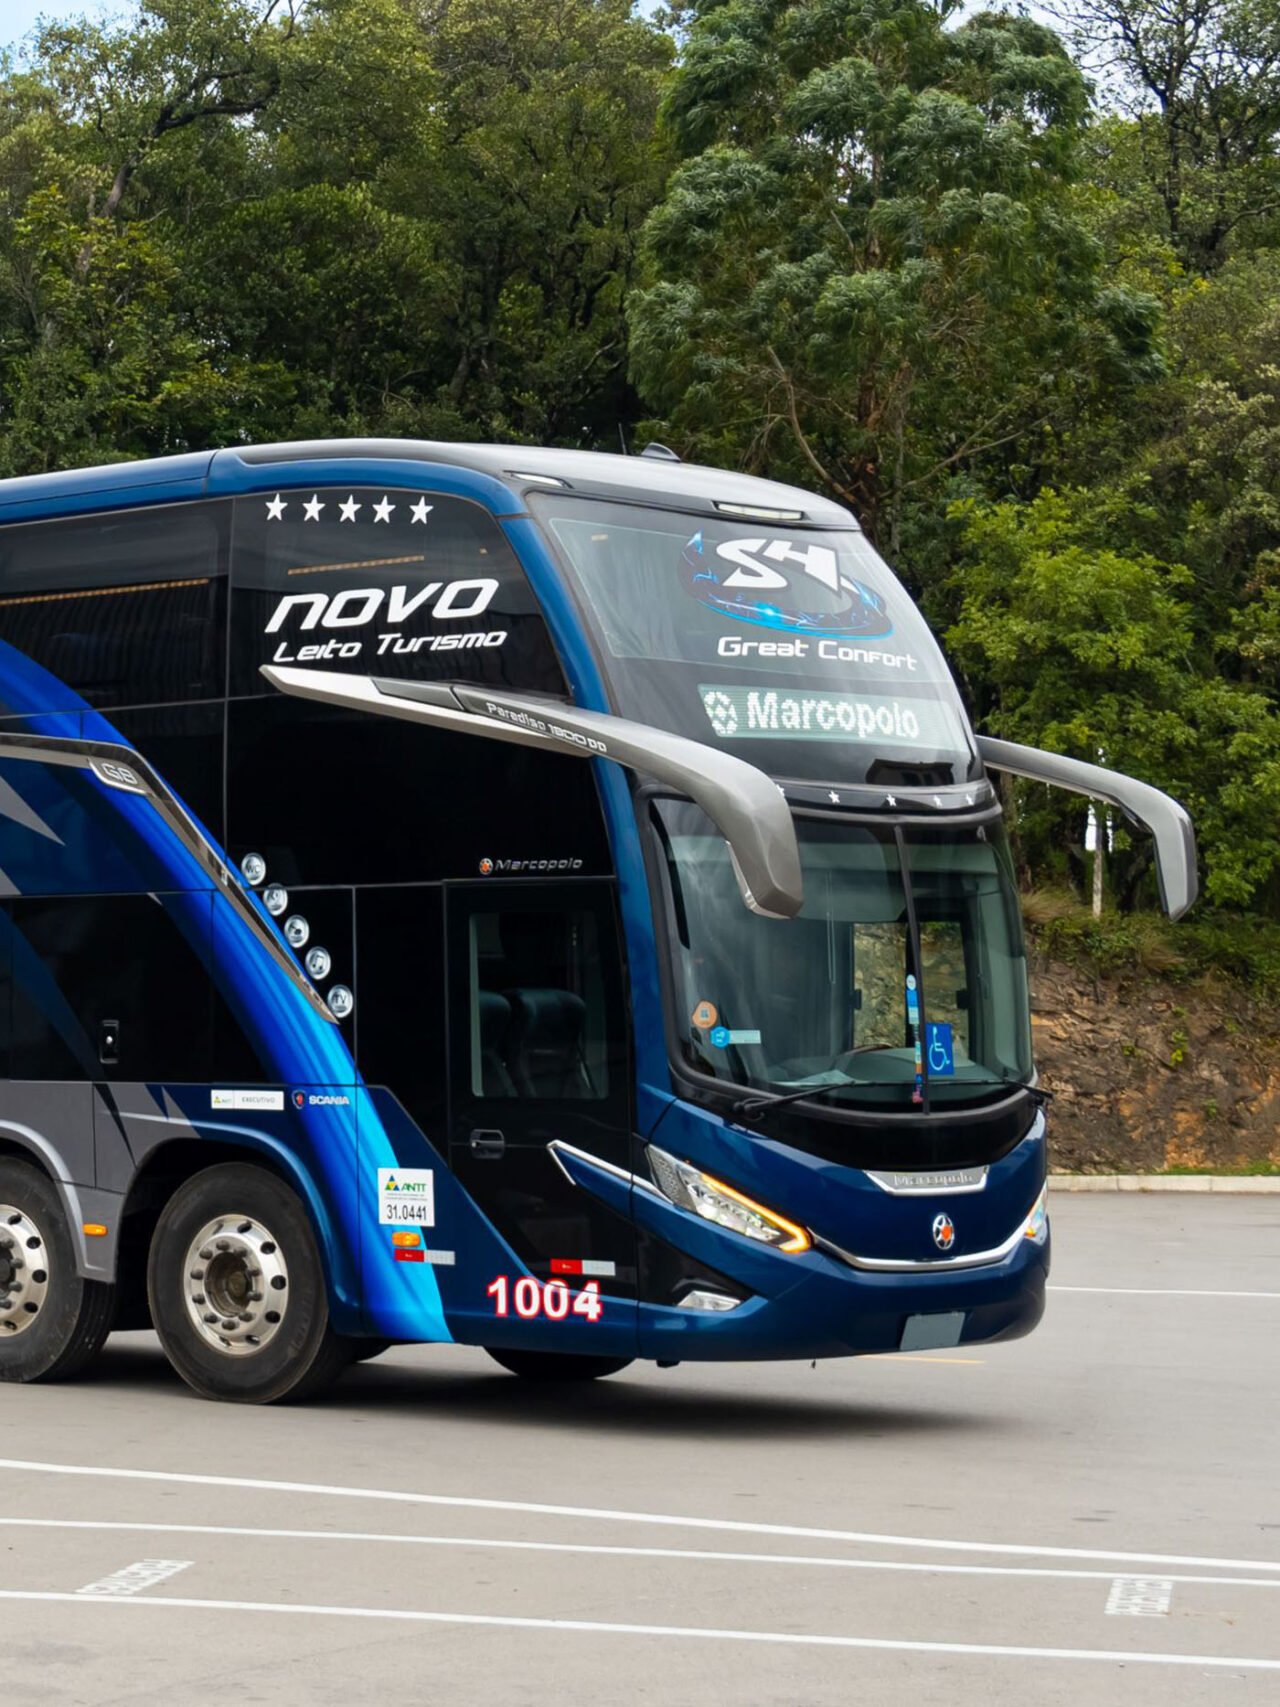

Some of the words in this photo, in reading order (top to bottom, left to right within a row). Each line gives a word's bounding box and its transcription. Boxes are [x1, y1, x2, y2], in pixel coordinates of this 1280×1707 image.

[716, 538, 841, 592] SH
[272, 638, 362, 663] Leito
[376, 630, 507, 656] Turismo
[717, 636, 809, 658] Great
[818, 639, 918, 671] Confort
[486, 702, 546, 731] Paradiso
[746, 691, 919, 739] Marcopolo
[101, 762, 138, 785] G8
[495, 857, 583, 872] Marcopolo
[241, 1096, 276, 1105] EXECUTIVO
[309, 1095, 350, 1105] SCANIA
[401, 1183, 427, 1192] ANTT
[386, 1204, 427, 1221] 31.0441
[487, 1274, 605, 1322] 1004
